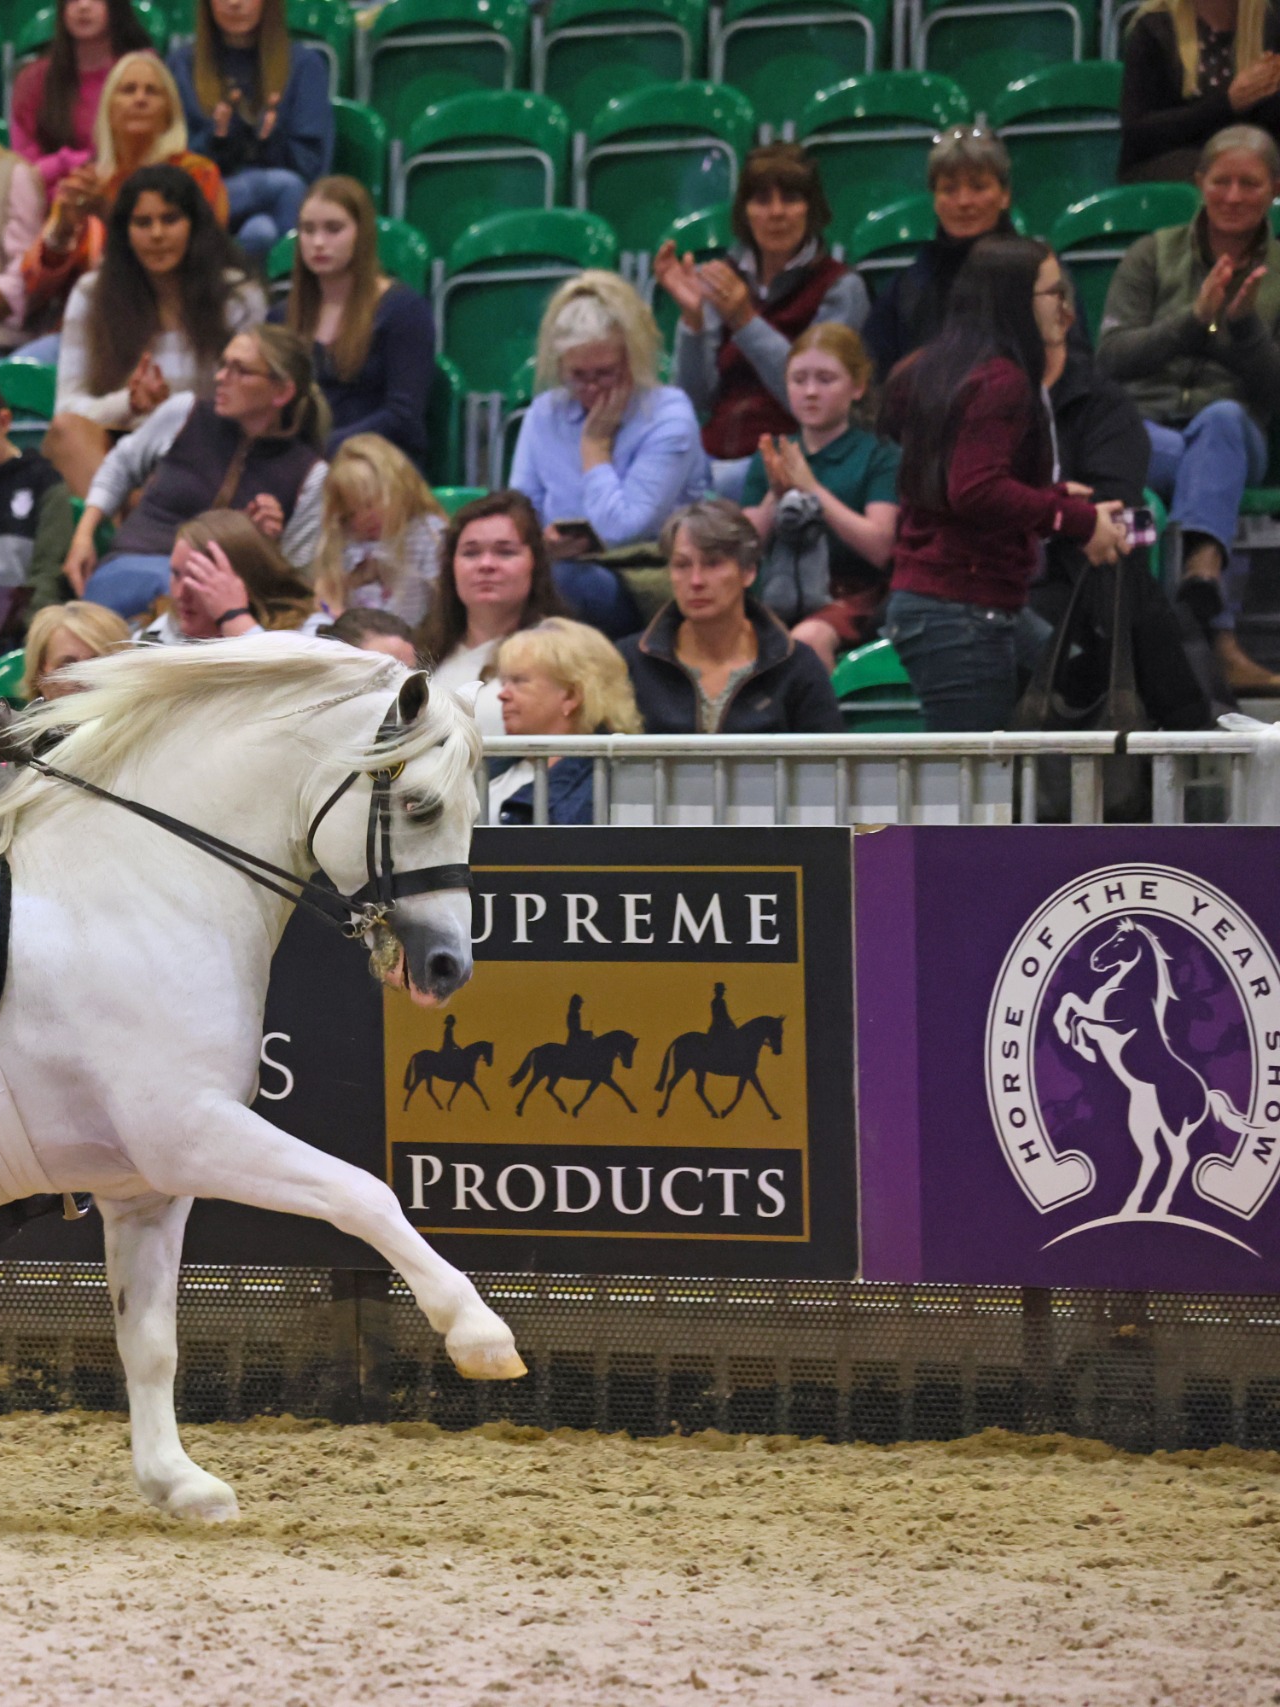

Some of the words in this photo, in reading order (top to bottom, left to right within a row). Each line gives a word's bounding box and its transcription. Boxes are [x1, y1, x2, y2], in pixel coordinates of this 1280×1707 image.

[471, 892, 780, 945] UPREME
[1001, 1006, 1041, 1164] HORSE
[1021, 926, 1056, 978] OF
[1073, 880, 1158, 914] THE
[1190, 896, 1272, 999] YEAR
[1252, 1030, 1280, 1165] SHOW
[406, 1154, 787, 1218] PRODUCTS
